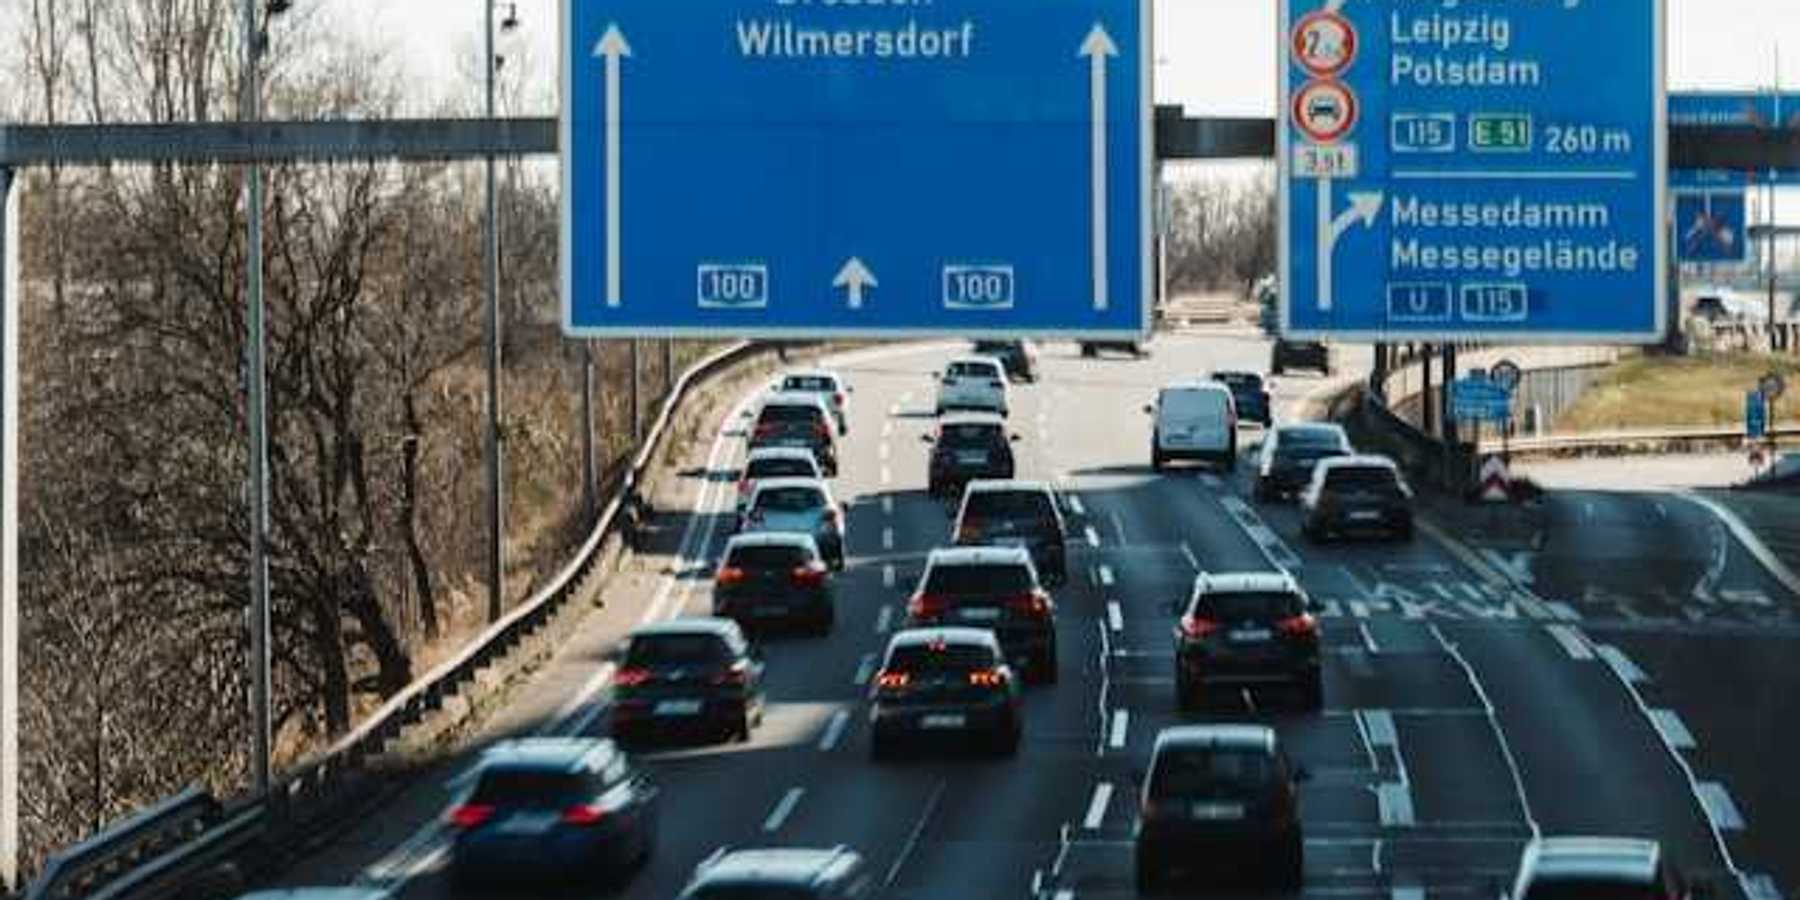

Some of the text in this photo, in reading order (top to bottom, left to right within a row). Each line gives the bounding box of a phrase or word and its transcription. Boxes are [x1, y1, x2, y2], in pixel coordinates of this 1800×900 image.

[736, 18, 973, 57] Wilmersdorf
[1392, 9, 1510, 51] Leipzig
[1392, 53, 1539, 86] Potsdam
[1408, 120, 1441, 145] 115
[1476, 120, 1490, 145] E
[1545, 125, 1630, 153] 260 m
[1391, 195, 1608, 228] Messedamm
[1391, 237, 1638, 277] Messegelände
[711, 274, 755, 300] 100
[957, 274, 1001, 300] 100
[1409, 289, 1428, 313] U
[1476, 289, 1512, 313] 115
